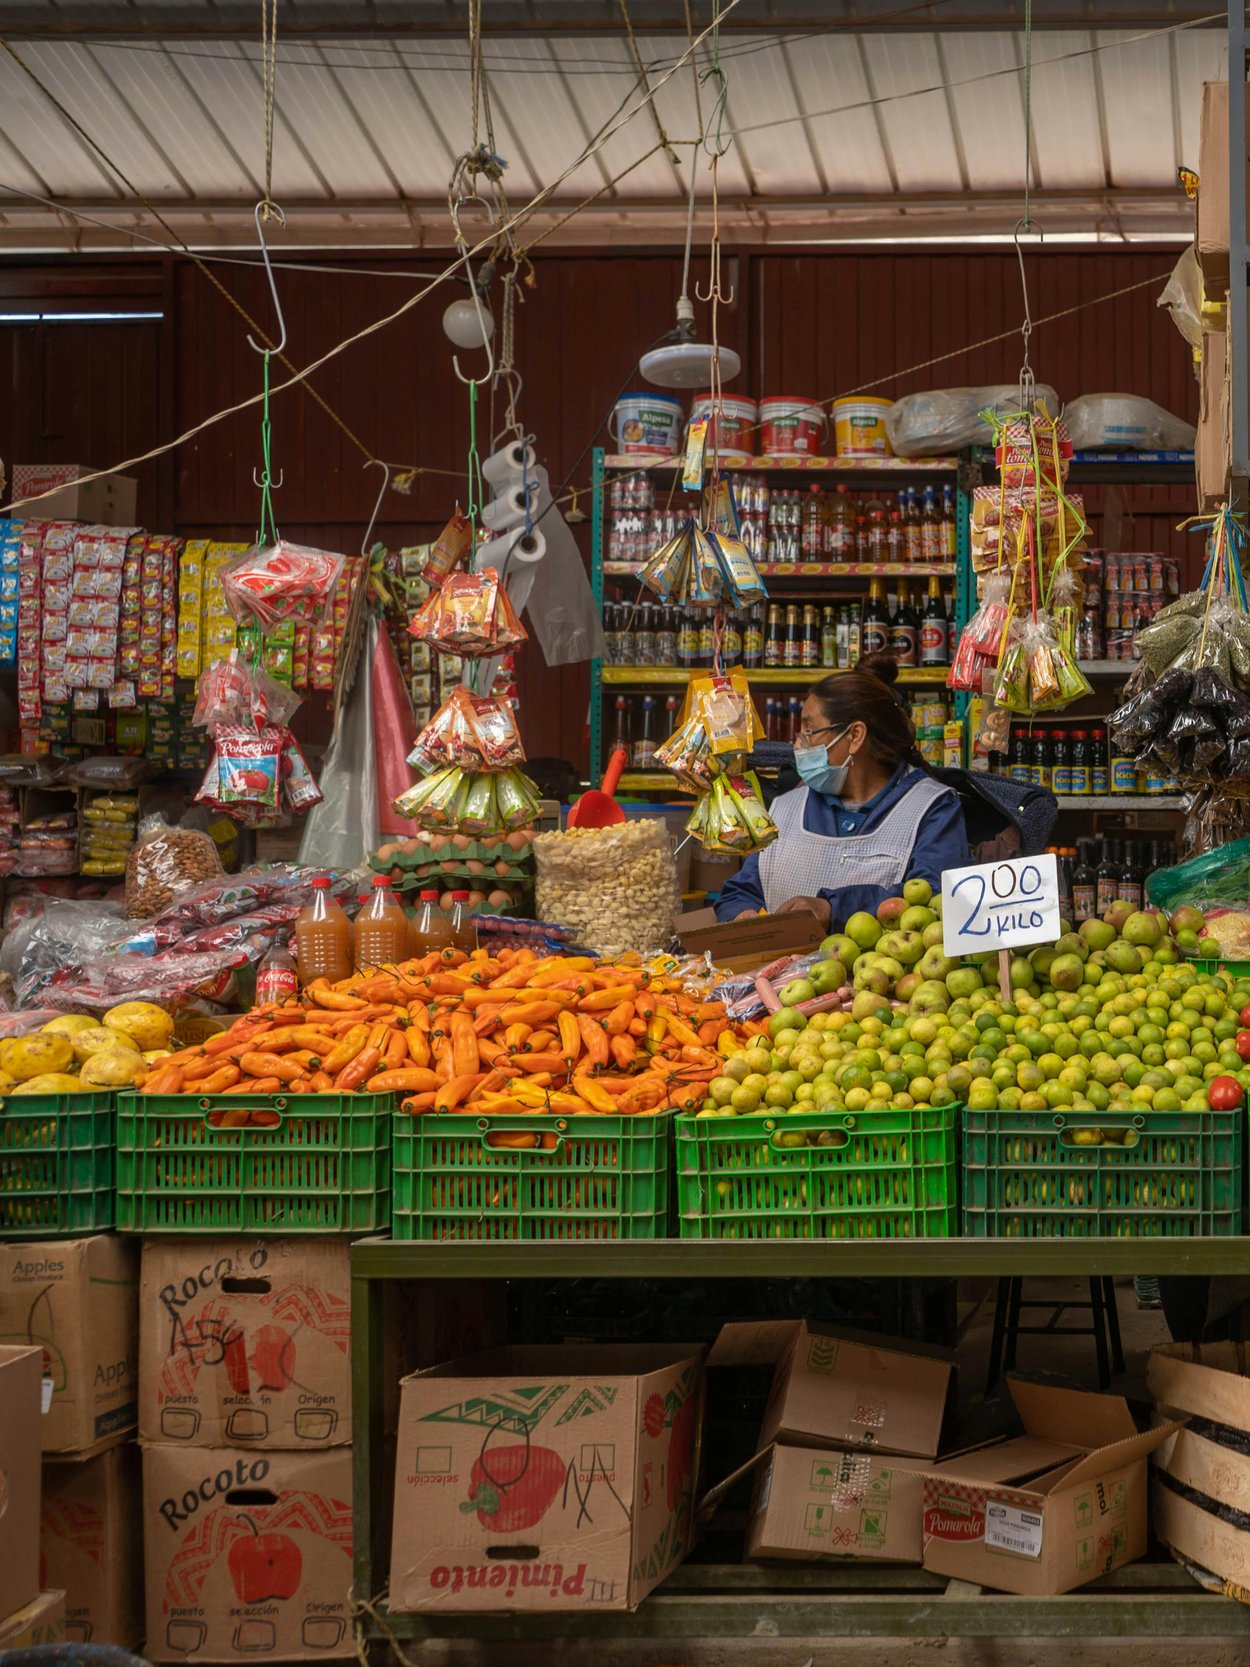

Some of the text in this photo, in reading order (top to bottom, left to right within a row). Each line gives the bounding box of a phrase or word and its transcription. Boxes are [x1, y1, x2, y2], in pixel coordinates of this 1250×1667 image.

[996, 911, 1043, 937] KILO
[13, 1260, 64, 1276] Apples
[160, 1247, 268, 1318] Rocoo
[94, 1358, 134, 1387] Appl
[165, 1395, 198, 1406] puesto
[298, 1394, 336, 1407] Origen
[407, 1474, 459, 1488] selección
[579, 1474, 616, 1485] puesto
[159, 1459, 270, 1533] Rocoto
[930, 1513, 981, 1535] Pomarola
[430, 1564, 587, 1598] Pimiento
[170, 1607, 204, 1617] puesto
[230, 1603, 279, 1616] seección
